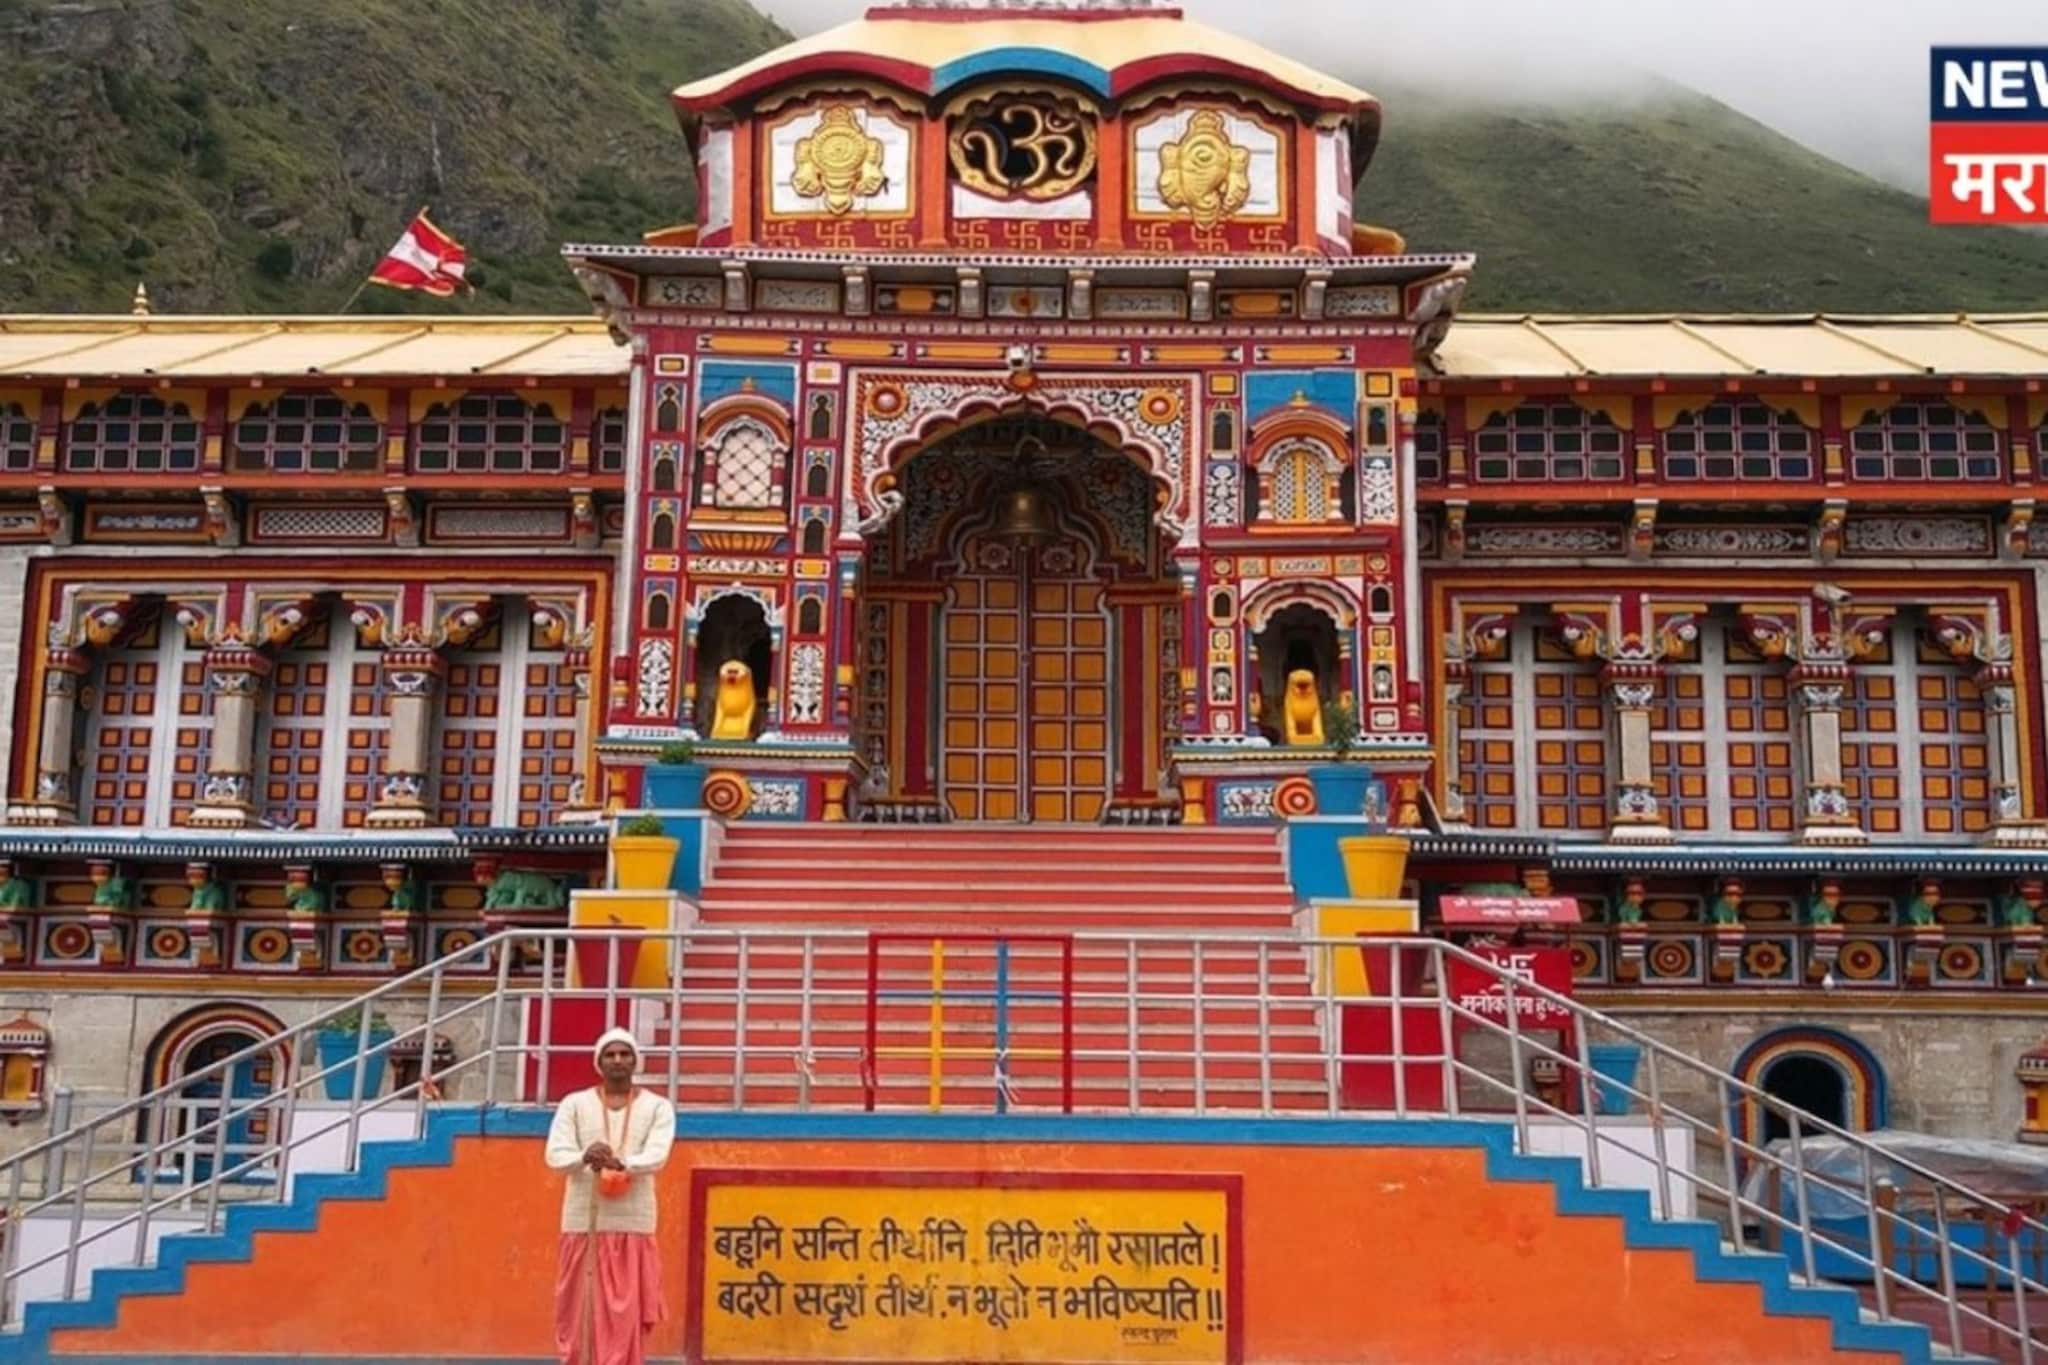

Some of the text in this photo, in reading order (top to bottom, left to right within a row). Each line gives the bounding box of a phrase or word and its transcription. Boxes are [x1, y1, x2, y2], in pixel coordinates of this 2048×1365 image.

[714, 1215, 783, 1268] बहूनि
[792, 1216, 862, 1261] सन्ति
[717, 1270, 785, 1319] बदरी
[1063, 1275, 1200, 1322] भविष्यति
